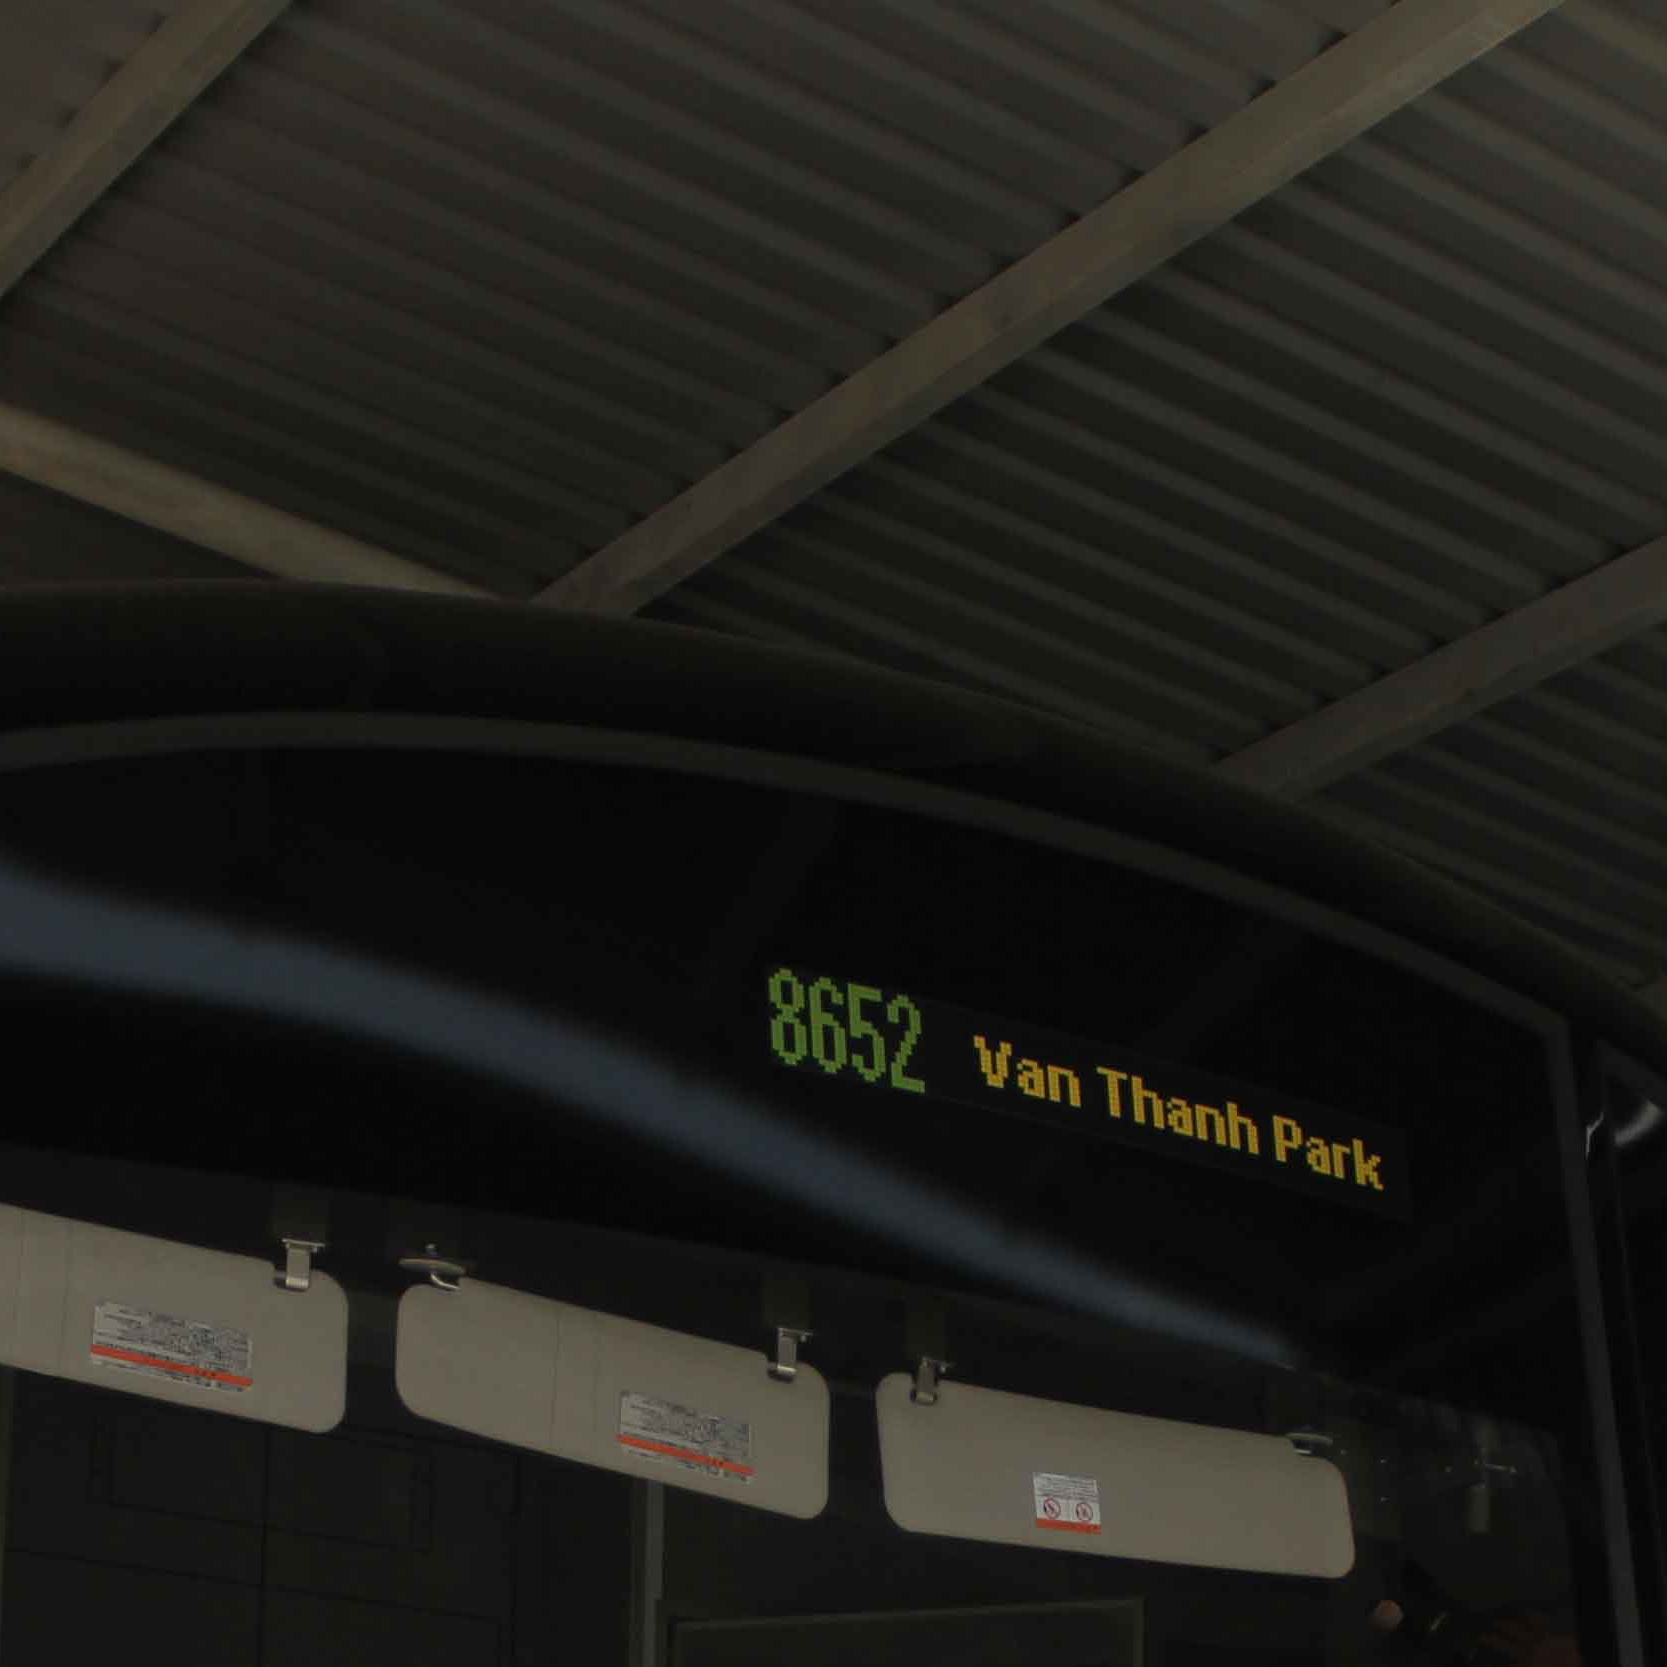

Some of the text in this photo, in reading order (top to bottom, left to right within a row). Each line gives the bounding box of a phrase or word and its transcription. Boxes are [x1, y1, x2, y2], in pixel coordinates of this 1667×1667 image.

[768, 968, 1384, 1191] 8652 Van Thanh Park
